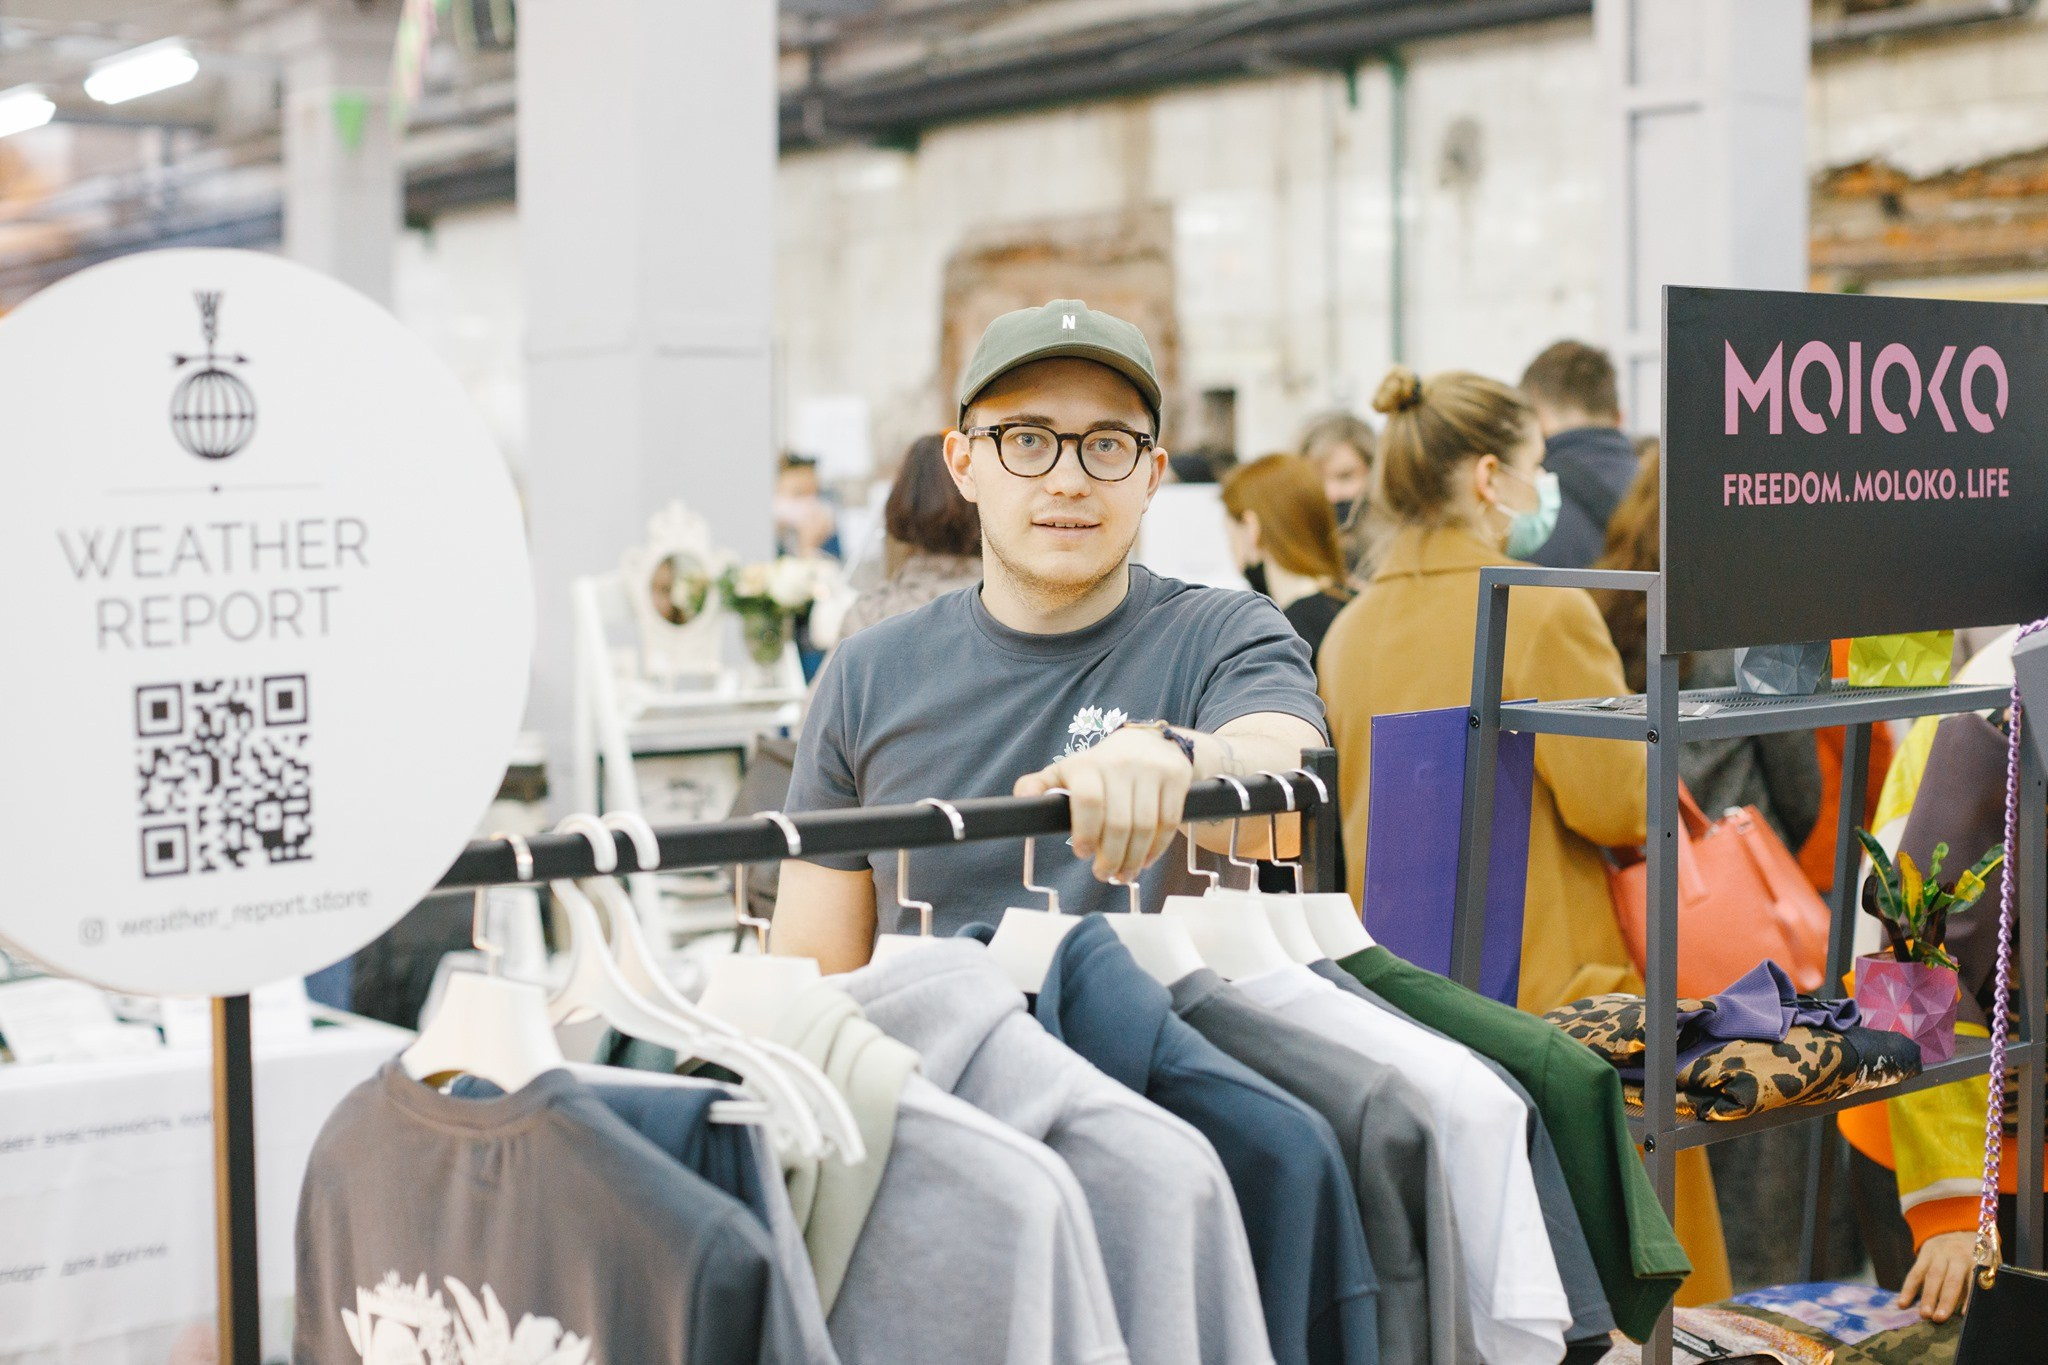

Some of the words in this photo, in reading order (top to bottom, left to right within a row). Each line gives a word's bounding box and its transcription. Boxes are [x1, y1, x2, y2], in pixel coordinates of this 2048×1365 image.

[1723, 467, 2010, 507] FREEDOM.MOLOKO.LIFE
[57, 518, 370, 581] WEATHER
[97, 586, 340, 650] REPORT
